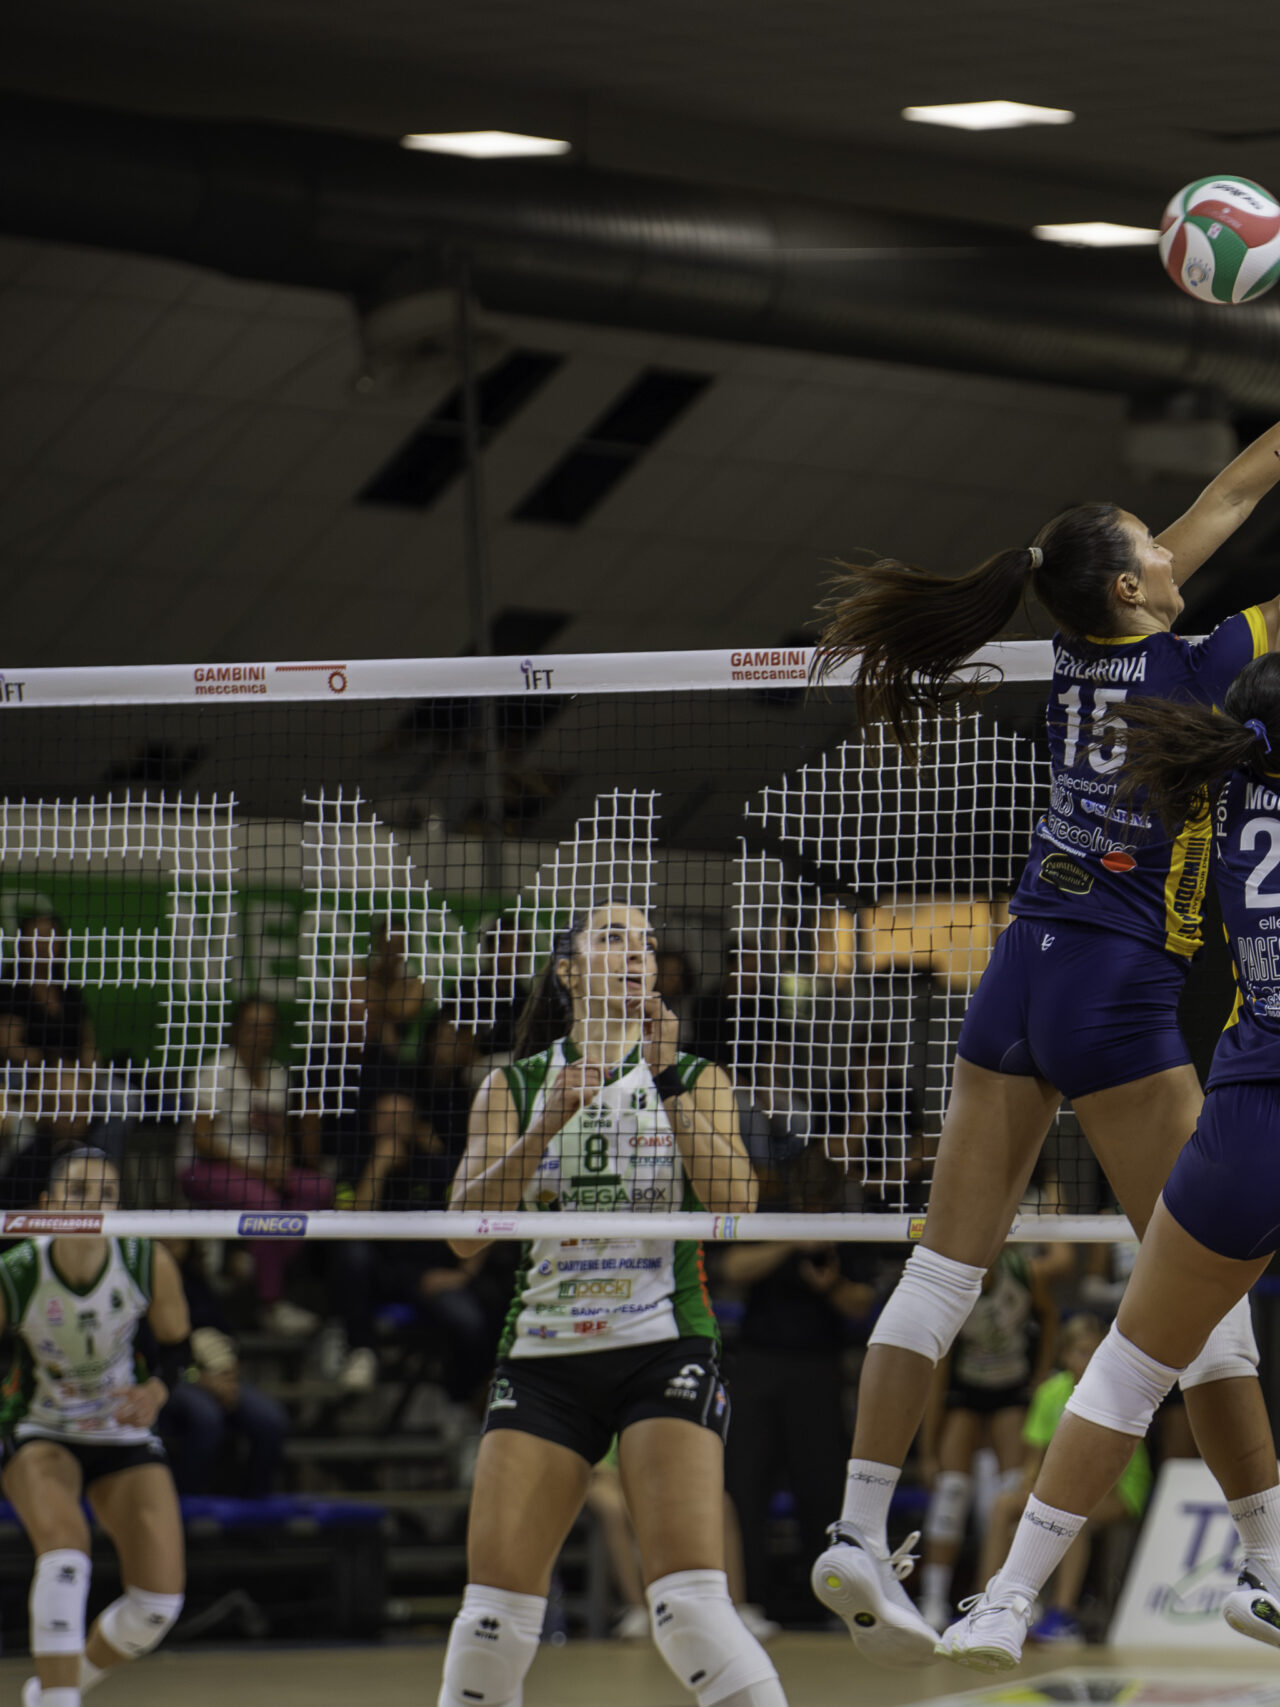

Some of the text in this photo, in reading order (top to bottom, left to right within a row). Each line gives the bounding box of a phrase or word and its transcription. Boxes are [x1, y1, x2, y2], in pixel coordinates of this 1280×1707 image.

[730, 651, 806, 667] GAMBINI
[194, 666, 266, 682] GAMBINI
[731, 668, 806, 680] meccanica
[195, 684, 267, 695] meccanica
[1057, 685, 1128, 775] 15
[629, 1136, 673, 1147] COMIS
[584, 1133, 609, 1172] 8
[243, 1217, 303, 1233] FINECO
